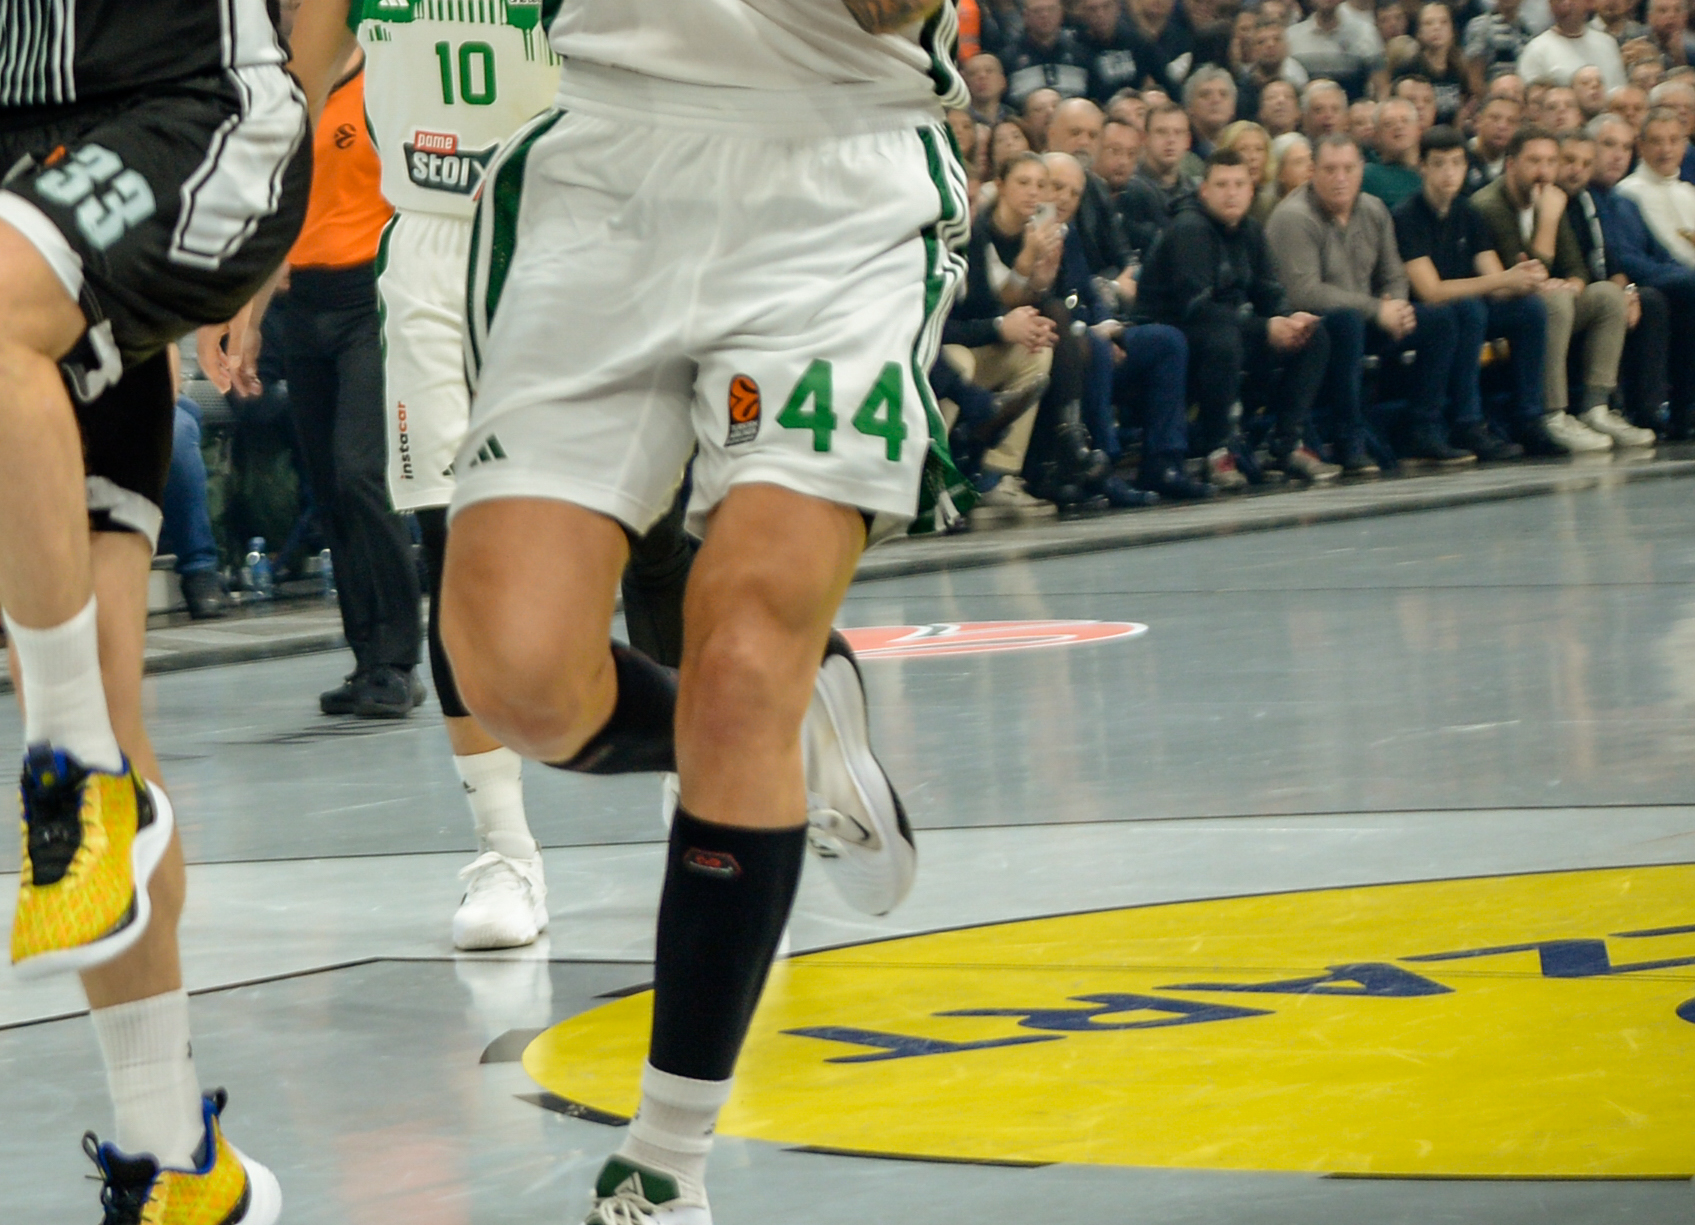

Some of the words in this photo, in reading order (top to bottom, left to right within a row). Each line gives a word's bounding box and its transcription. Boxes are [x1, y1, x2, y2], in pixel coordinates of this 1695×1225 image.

[435, 40, 497, 106] 10
[417, 133, 454, 150] pame
[34, 142, 156, 250] 33
[398, 400, 414, 480] instacar
[775, 357, 908, 463] 44
